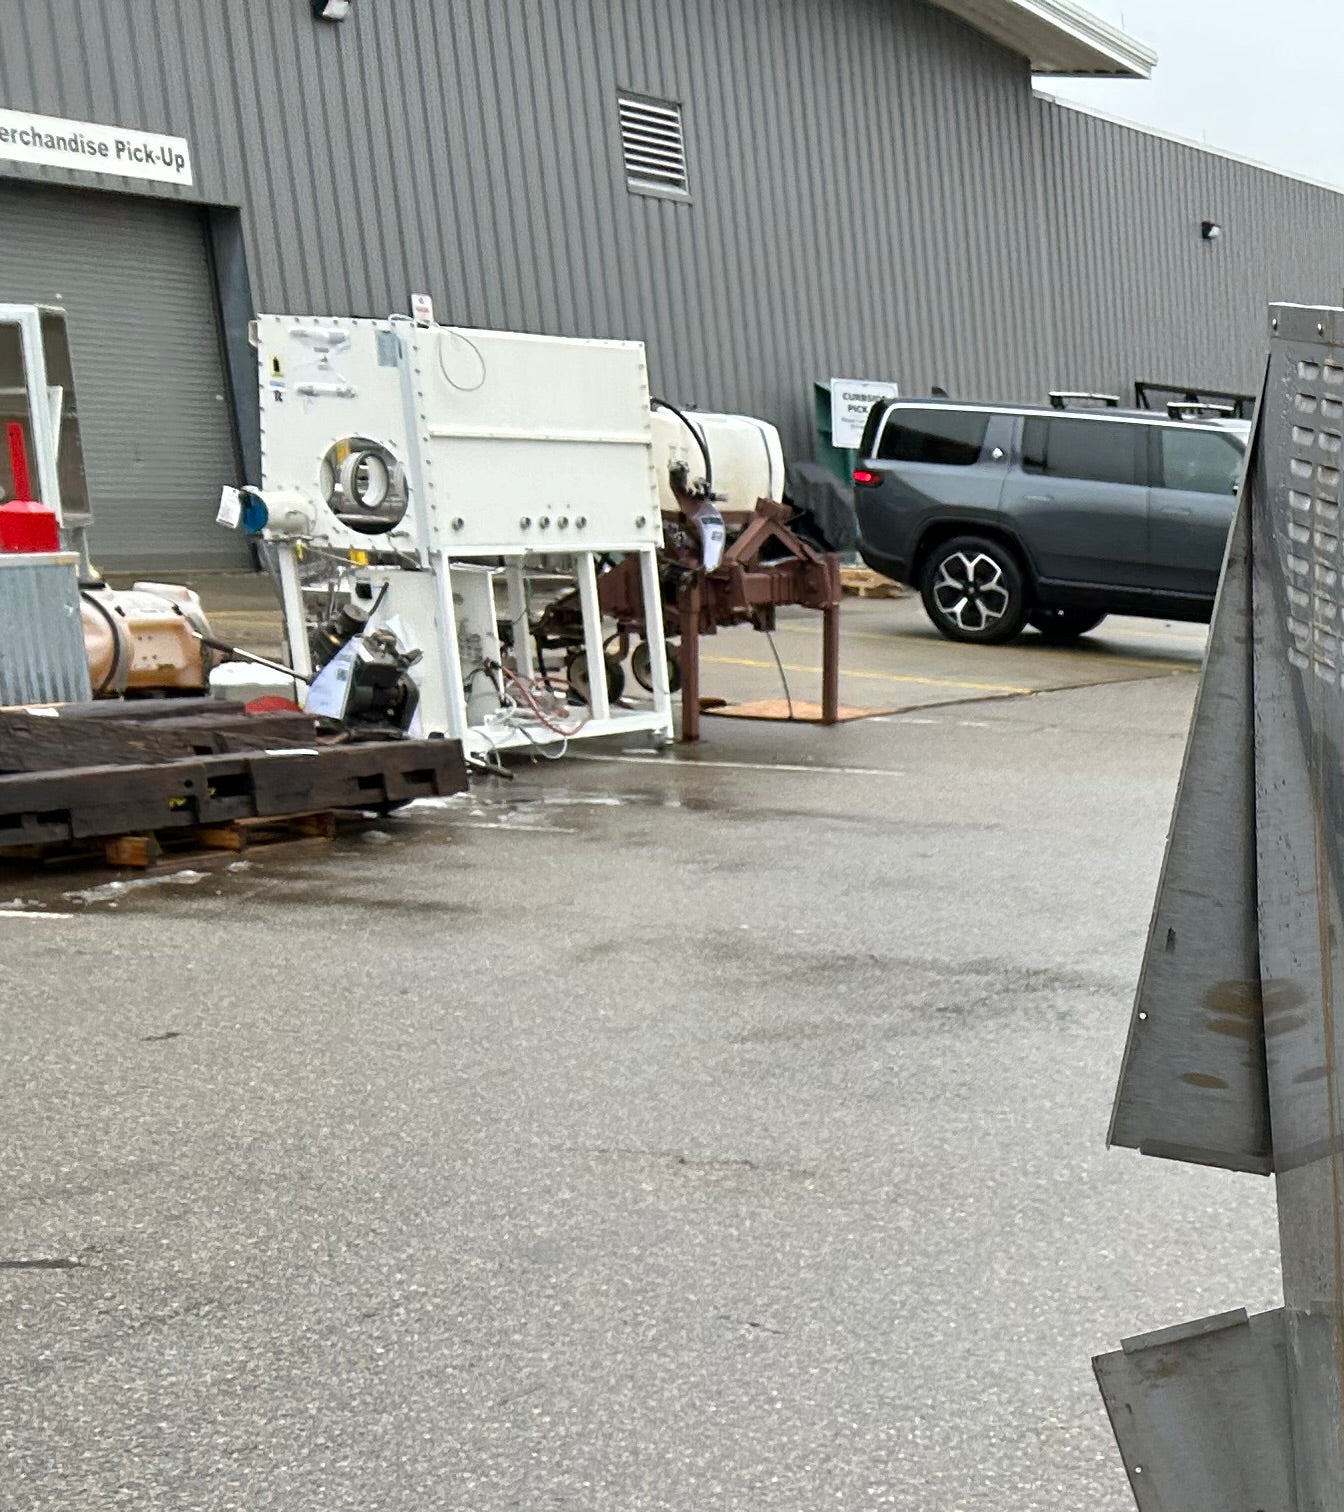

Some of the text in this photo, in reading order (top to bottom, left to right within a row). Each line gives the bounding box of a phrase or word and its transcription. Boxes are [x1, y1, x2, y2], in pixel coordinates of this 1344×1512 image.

[0, 126, 185, 172] erchandise Pick-Up
[842, 392, 884, 402] CURBSID
